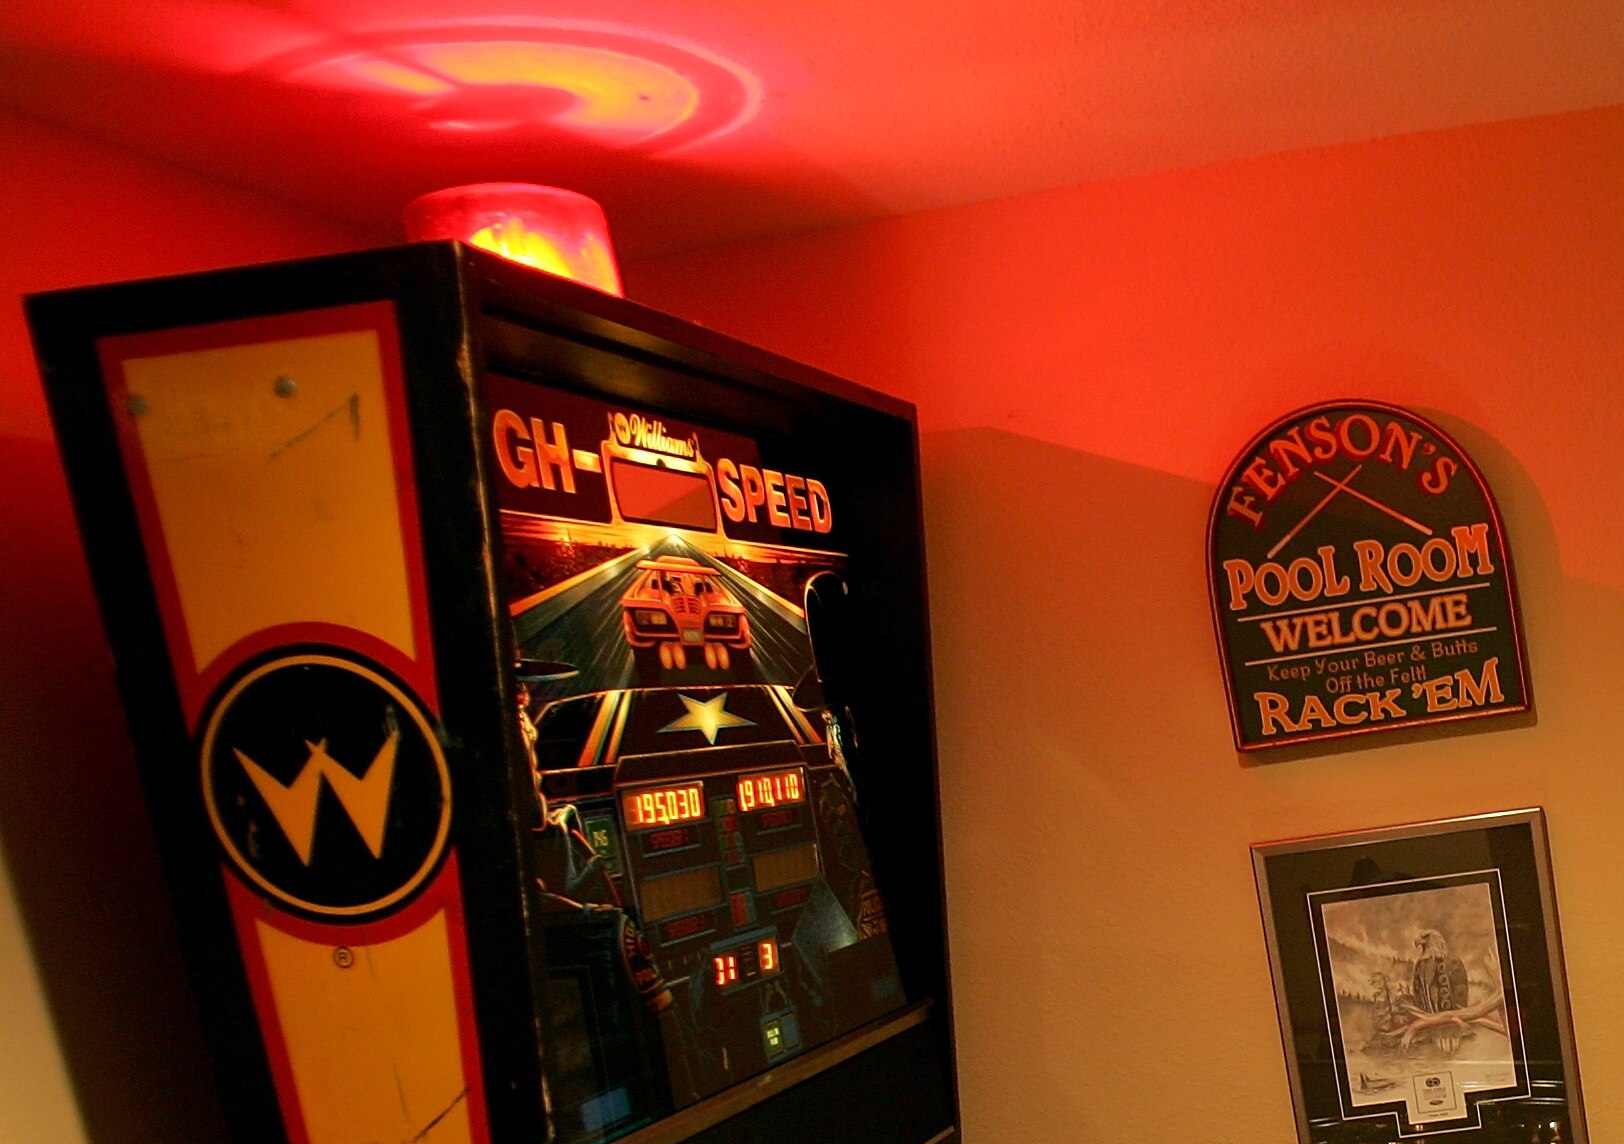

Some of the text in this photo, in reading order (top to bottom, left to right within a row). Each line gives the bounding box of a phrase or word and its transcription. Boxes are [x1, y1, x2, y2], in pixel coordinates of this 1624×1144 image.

[629, 413, 694, 458] Williams
[1227, 413, 1458, 530] FENSON'S
[716, 458, 832, 533] SPEED
[1223, 523, 1495, 611] POOL ROOM
[1260, 593, 1473, 653] WELCOME
[1254, 657, 1505, 735] RACK 'EM
[1268, 639, 1479, 683] Keep Your Beer & Butts
[1325, 675, 1353, 694] Off
[1356, 670, 1385, 690] the
[232, 729, 398, 867] W
